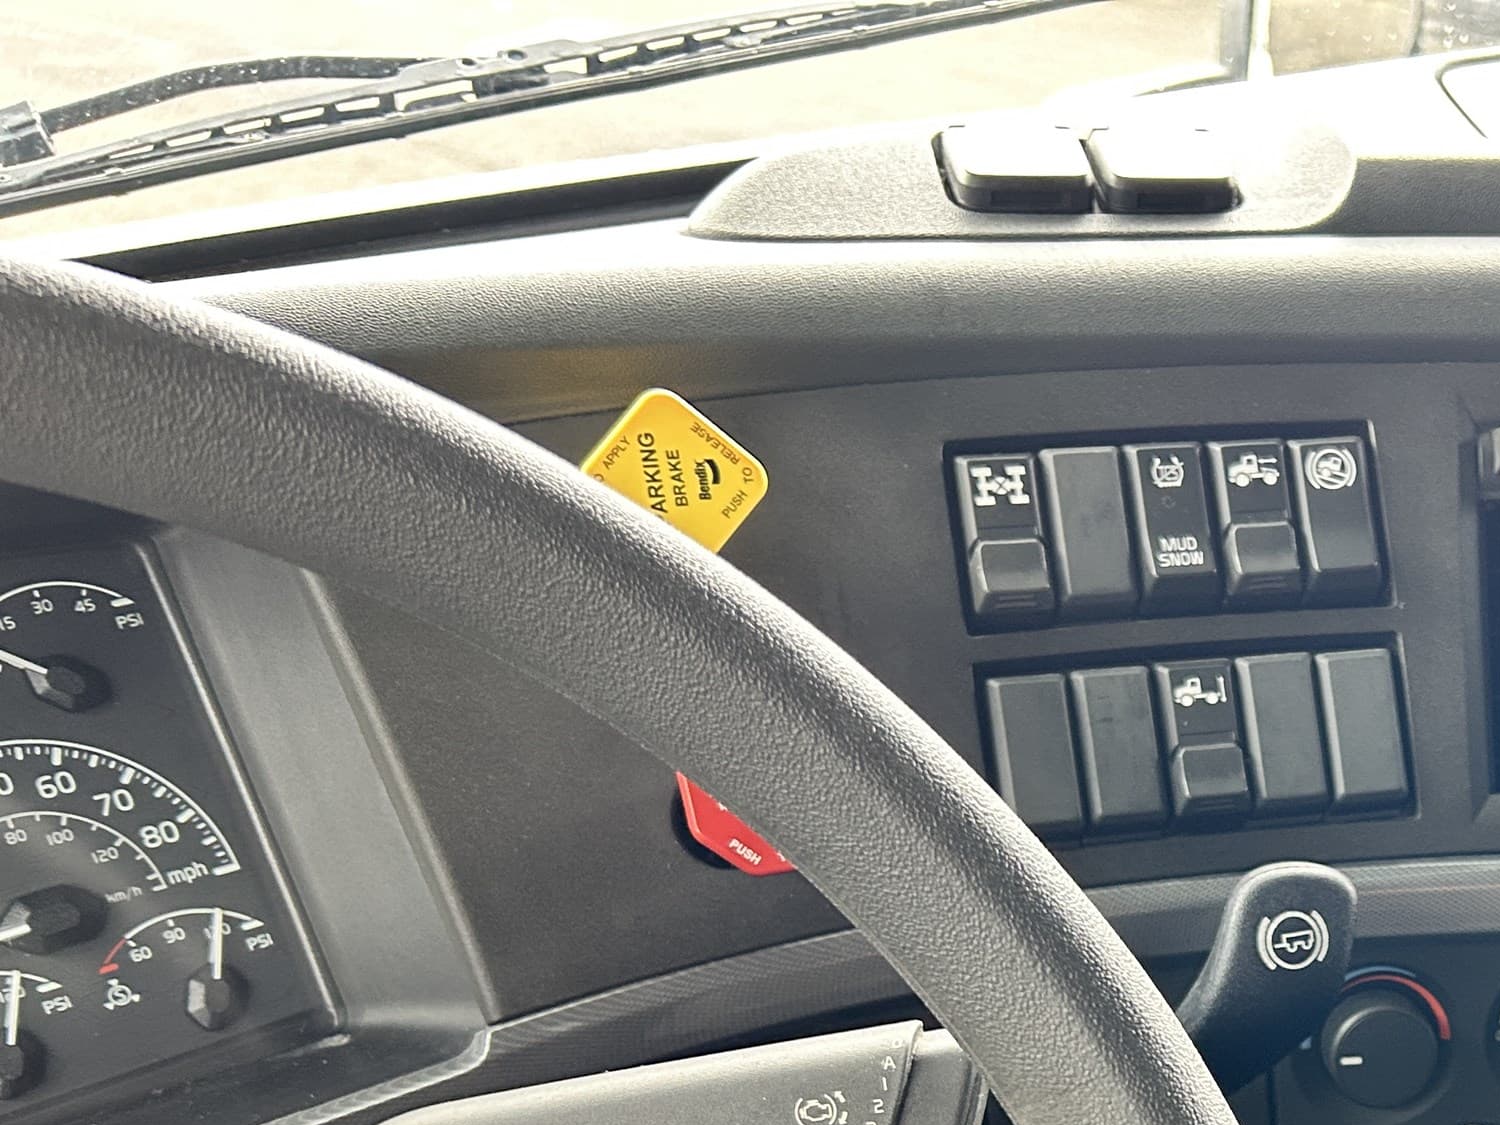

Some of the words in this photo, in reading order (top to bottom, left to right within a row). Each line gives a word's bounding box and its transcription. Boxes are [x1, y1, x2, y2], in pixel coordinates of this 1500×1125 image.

[602, 435, 632, 470] APPLY
[690, 422, 741, 465] RELEASE
[637, 432, 669, 514] ARKING
[666, 449, 689, 507] BRAKE
[694, 459, 712, 500] Bendix
[741, 466, 755, 485] TO
[721, 489, 749, 519] PUSH
[1158, 536, 1198, 552] MUD
[1158, 551, 1204, 568] SNOW
[30, 598, 54, 615] 30
[74, 598, 97, 613] 45
[114, 612, 145, 630] PSI
[35, 770, 77, 799] 60
[92, 788, 135, 817] 70
[4, 829, 28, 846] 80
[45, 828, 75, 847] 100
[139, 820, 180, 849] 80
[90, 846, 120, 865] 120
[728, 838, 763, 866] PUSH
[167, 861, 209, 885] mph
[105, 885, 143, 903] km/h
[162, 926, 187, 944] 90
[244, 932, 275, 951] PSI
[128, 945, 153, 963] 60
[40, 994, 73, 1015] PSI
[883, 1055, 897, 1071] A
[882, 1075, 888, 1092] 1
[872, 1098, 885, 1114] 2
